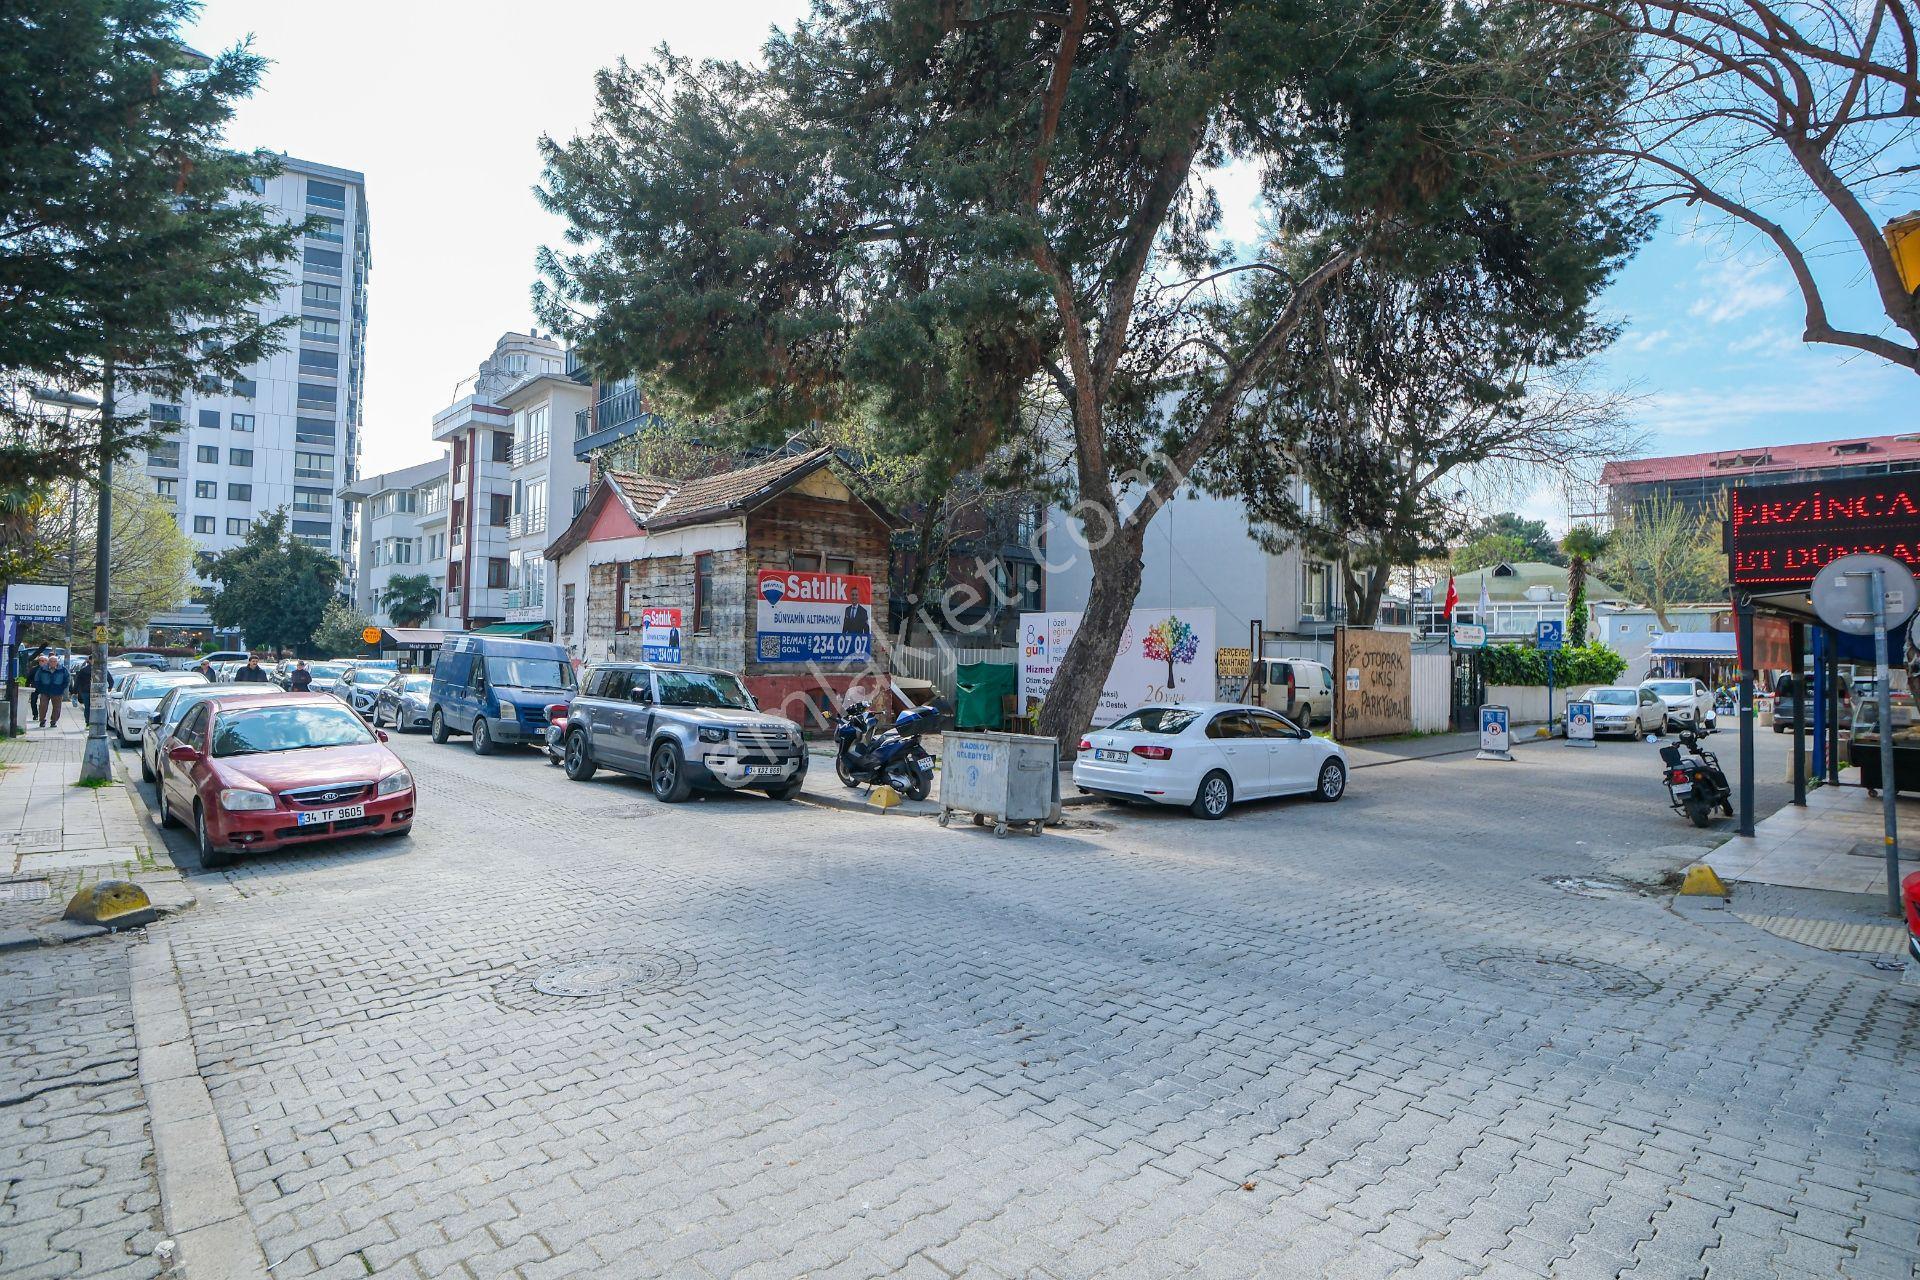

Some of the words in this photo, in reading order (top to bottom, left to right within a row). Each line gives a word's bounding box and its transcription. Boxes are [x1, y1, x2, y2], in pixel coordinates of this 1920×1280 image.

[787, 575, 848, 600] Satılık
[14, 602, 61, 612] bisiklethane
[651, 610, 672, 626] Satılık
[774, 612, 805, 624] BÜNYAMİN
[806, 615, 841, 625] ALTIPARMAK
[1052, 618, 1067, 627] özel
[1052, 628, 1074, 638] eğitim
[781, 635, 807, 645] RE/MAX
[812, 635, 835, 654] 234
[837, 636, 853, 654] 07
[854, 636, 868, 655] 07
[1025, 643, 1045, 657] gün
[1362, 652, 1403, 670] OTOPARK
[1026, 664, 1054, 674] Hizmet
[1144, 684, 1165, 703] 26
[304, 813, 317, 823] 34
[322, 810, 334, 821] TF
[338, 806, 362, 819] 9605
